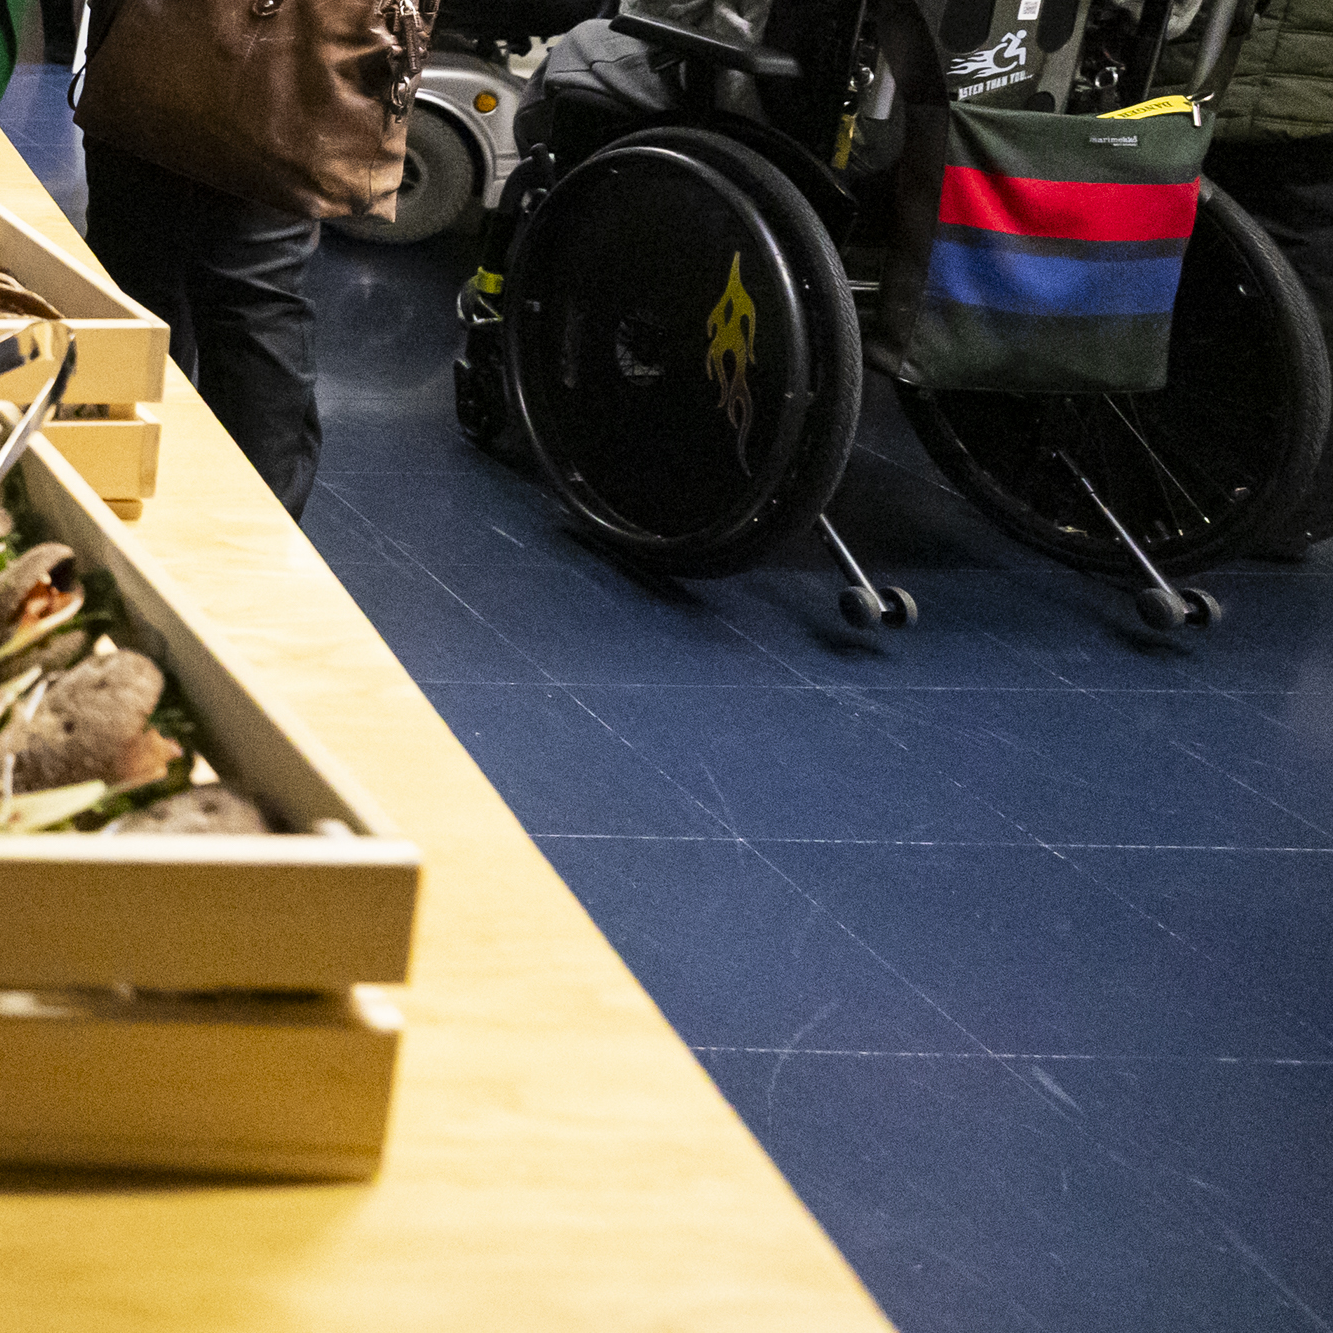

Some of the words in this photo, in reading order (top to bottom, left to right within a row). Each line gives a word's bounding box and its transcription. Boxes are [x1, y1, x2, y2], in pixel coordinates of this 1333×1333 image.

[985, 75, 1009, 91] THAN
[1117, 101, 1174, 119] DANGER
[1089, 135, 1138, 143] marimekko
